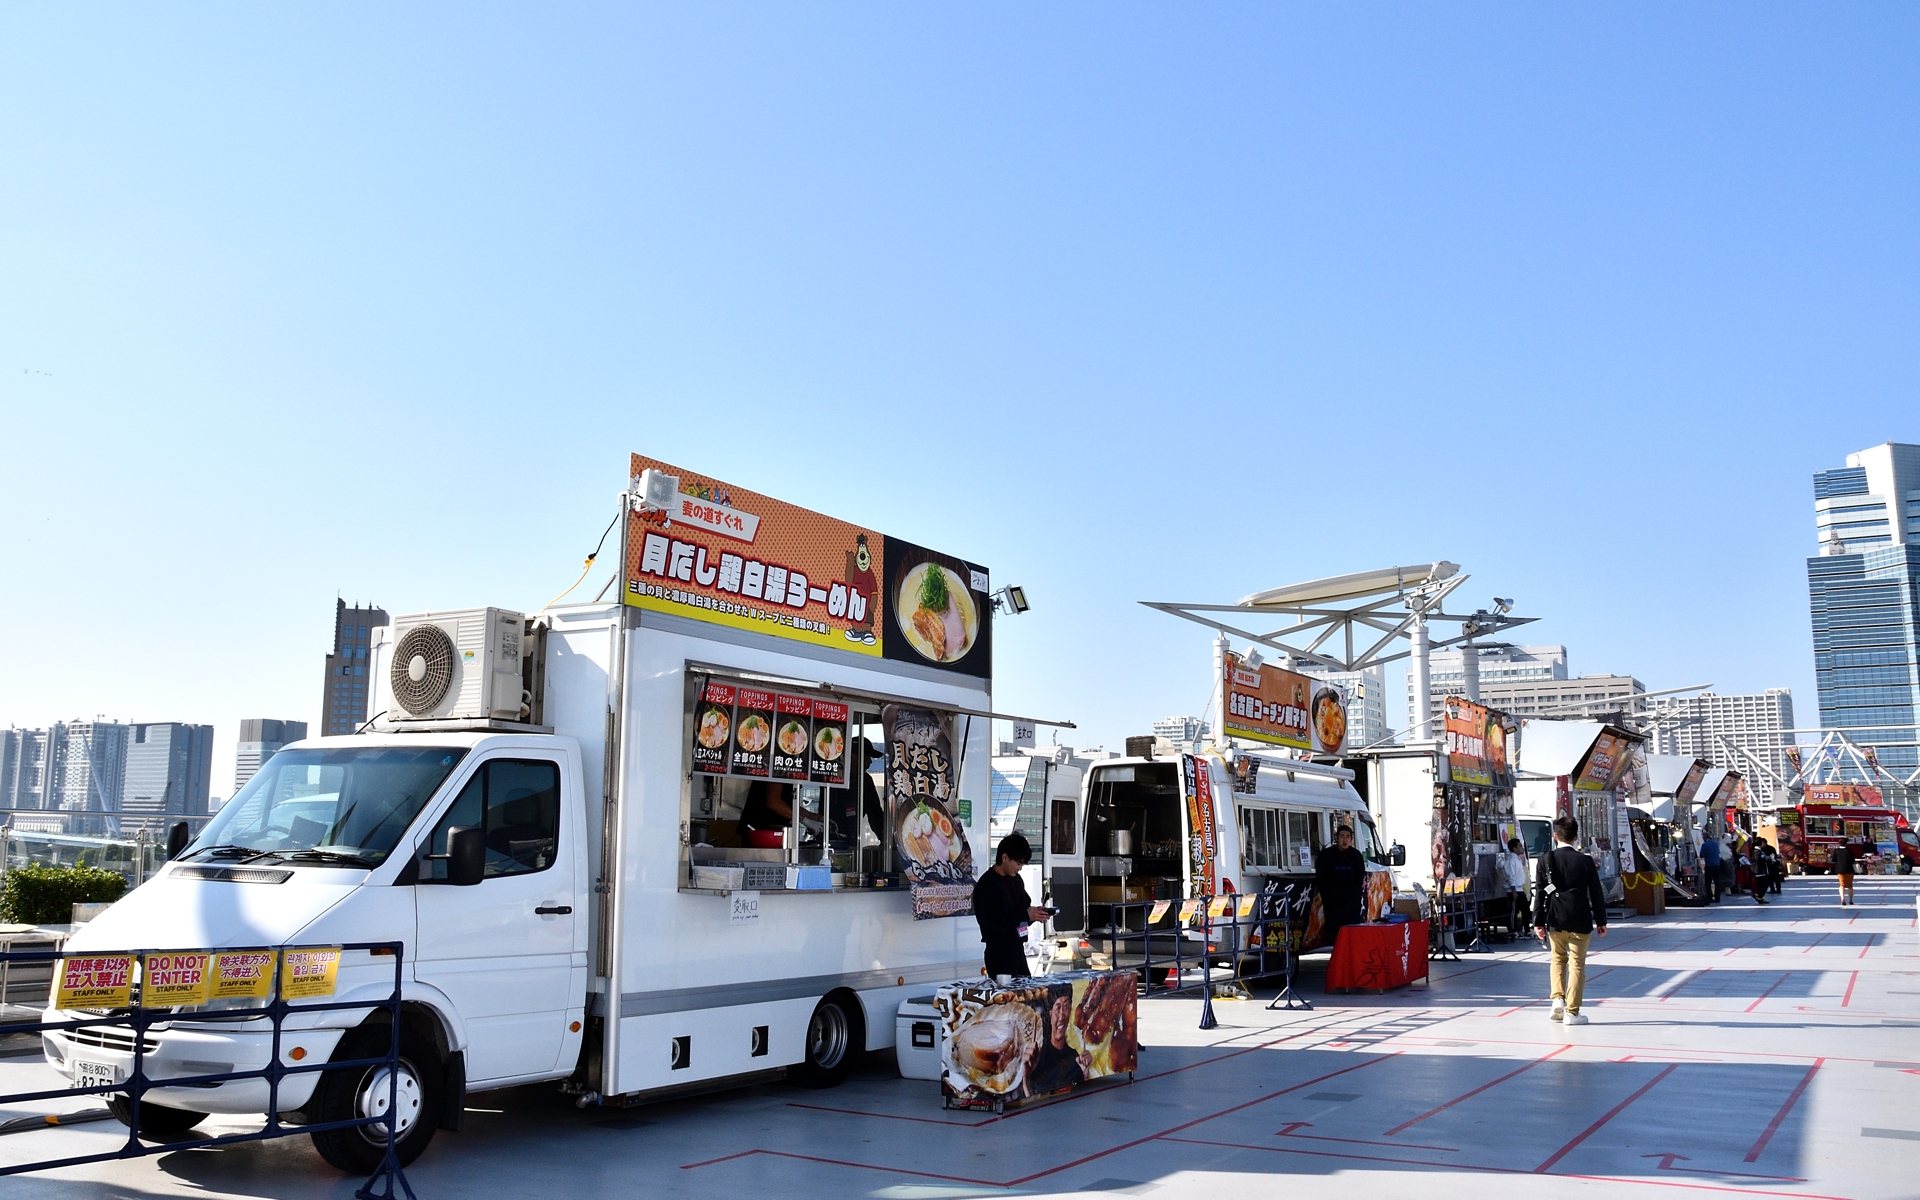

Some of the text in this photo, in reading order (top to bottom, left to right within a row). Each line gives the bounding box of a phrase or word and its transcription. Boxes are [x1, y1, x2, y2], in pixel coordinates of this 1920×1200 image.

[682, 500, 744, 532] 麦の道すぐれ
[641, 532, 868, 622] 貝だし鶏白湯らーめん
[740, 690, 768, 700] TOPPINGS
[779, 696, 805, 706] TOPPINGS
[747, 699, 773, 709] トッピング
[785, 705, 811, 714] トッピング
[815, 702, 841, 712] TOPPINGS
[1230, 692, 1308, 729] 名古屋コーチン親子丼
[821, 711, 847, 721] トッピング
[1015, 726, 1033, 740] 注文口
[734, 752, 763, 764] 全部のせ
[774, 756, 803, 767] 肉のせ
[892, 742, 948, 772] 貝だし
[812, 760, 838, 771] 味玉のせ
[893, 769, 950, 800] 鶏白湯
[911, 861, 963, 880] らーめん
[733, 897, 758, 914] 受取口
[67, 957, 131, 973] 関係者以外
[148, 955, 207, 971] DO NOT
[219, 953, 271, 968] 除关联方外
[287, 951, 337, 965] 관계자 이외의
[221, 966, 262, 980] 不得进入
[293, 963, 327, 977] 출입 금지
[63, 971, 128, 990] 立入禁止
[150, 970, 201, 987] ENTER
[95, 1065, 106, 1076] 800
